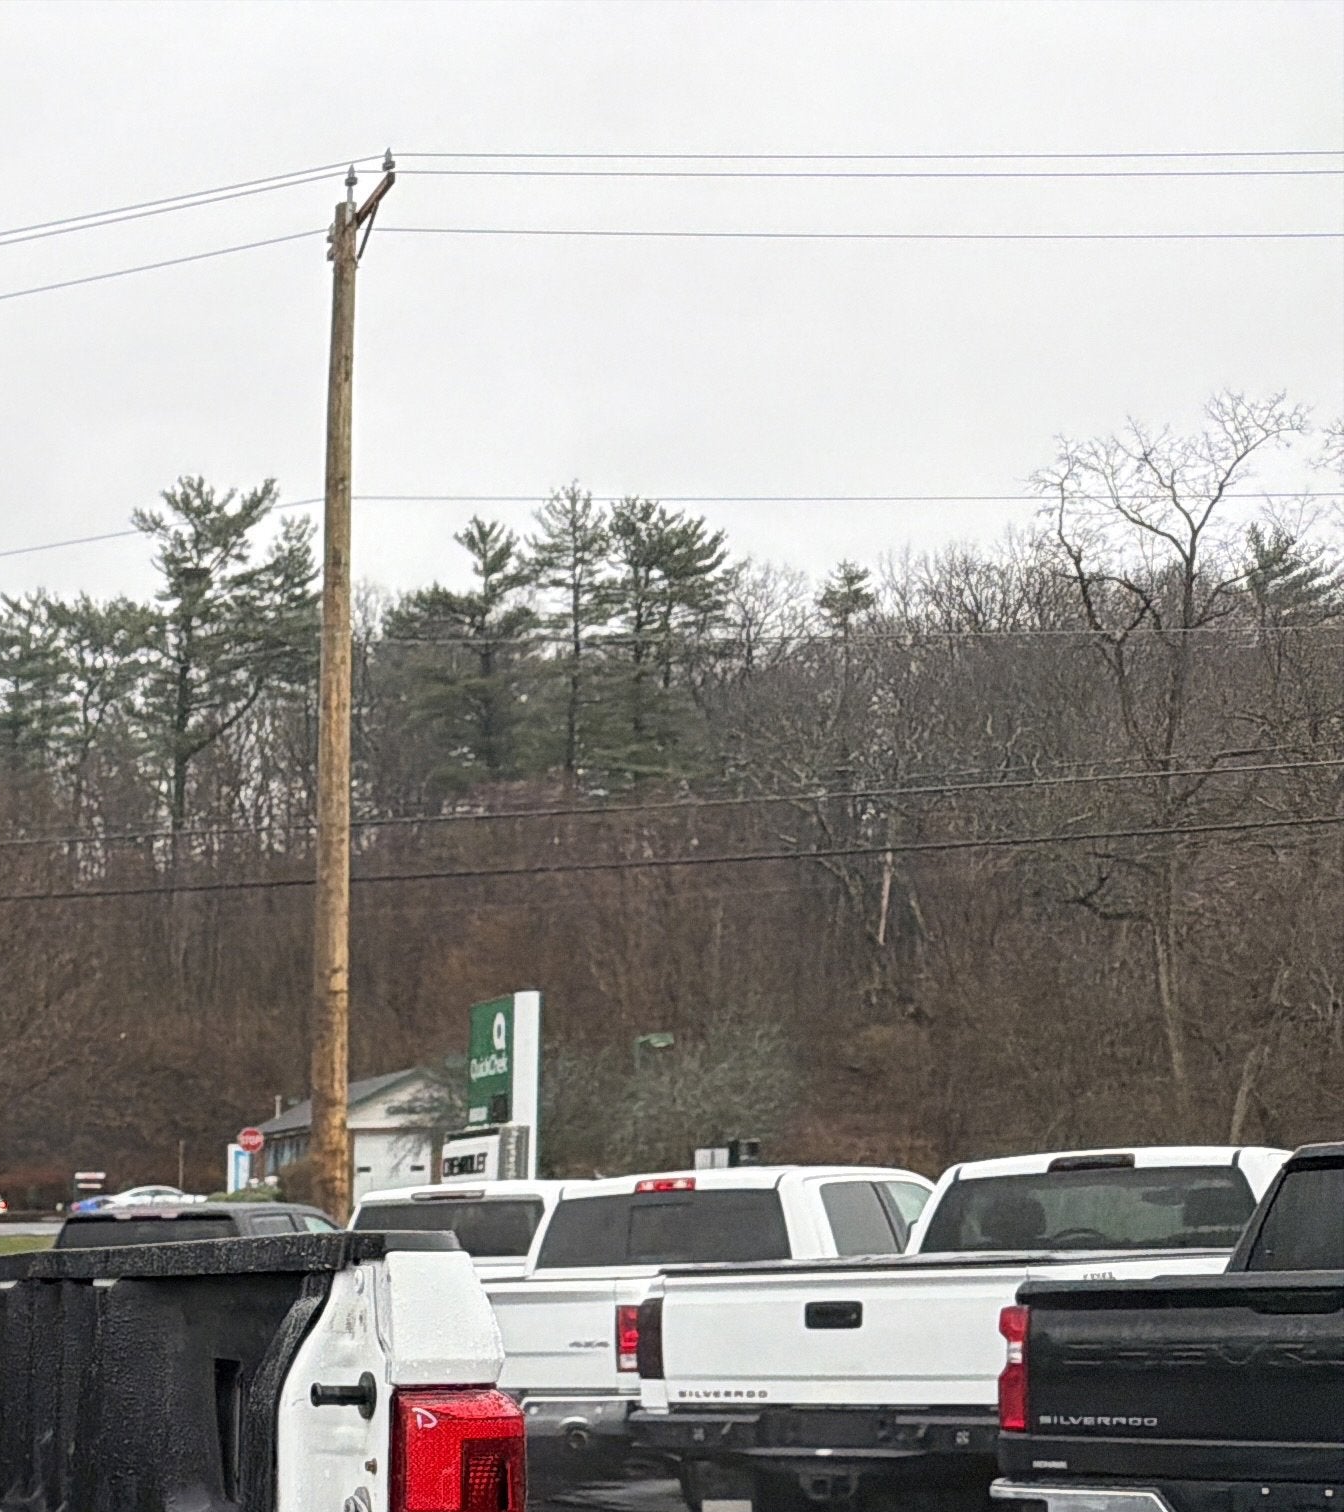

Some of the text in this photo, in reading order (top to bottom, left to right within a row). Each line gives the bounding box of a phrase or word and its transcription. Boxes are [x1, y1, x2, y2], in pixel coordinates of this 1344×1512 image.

[241, 1134, 264, 1146] STOP
[443, 1152, 488, 1177] CHEVROLET
[678, 1390, 768, 1399] SILVERADO
[1039, 1415, 1158, 1427] SILVERADO
